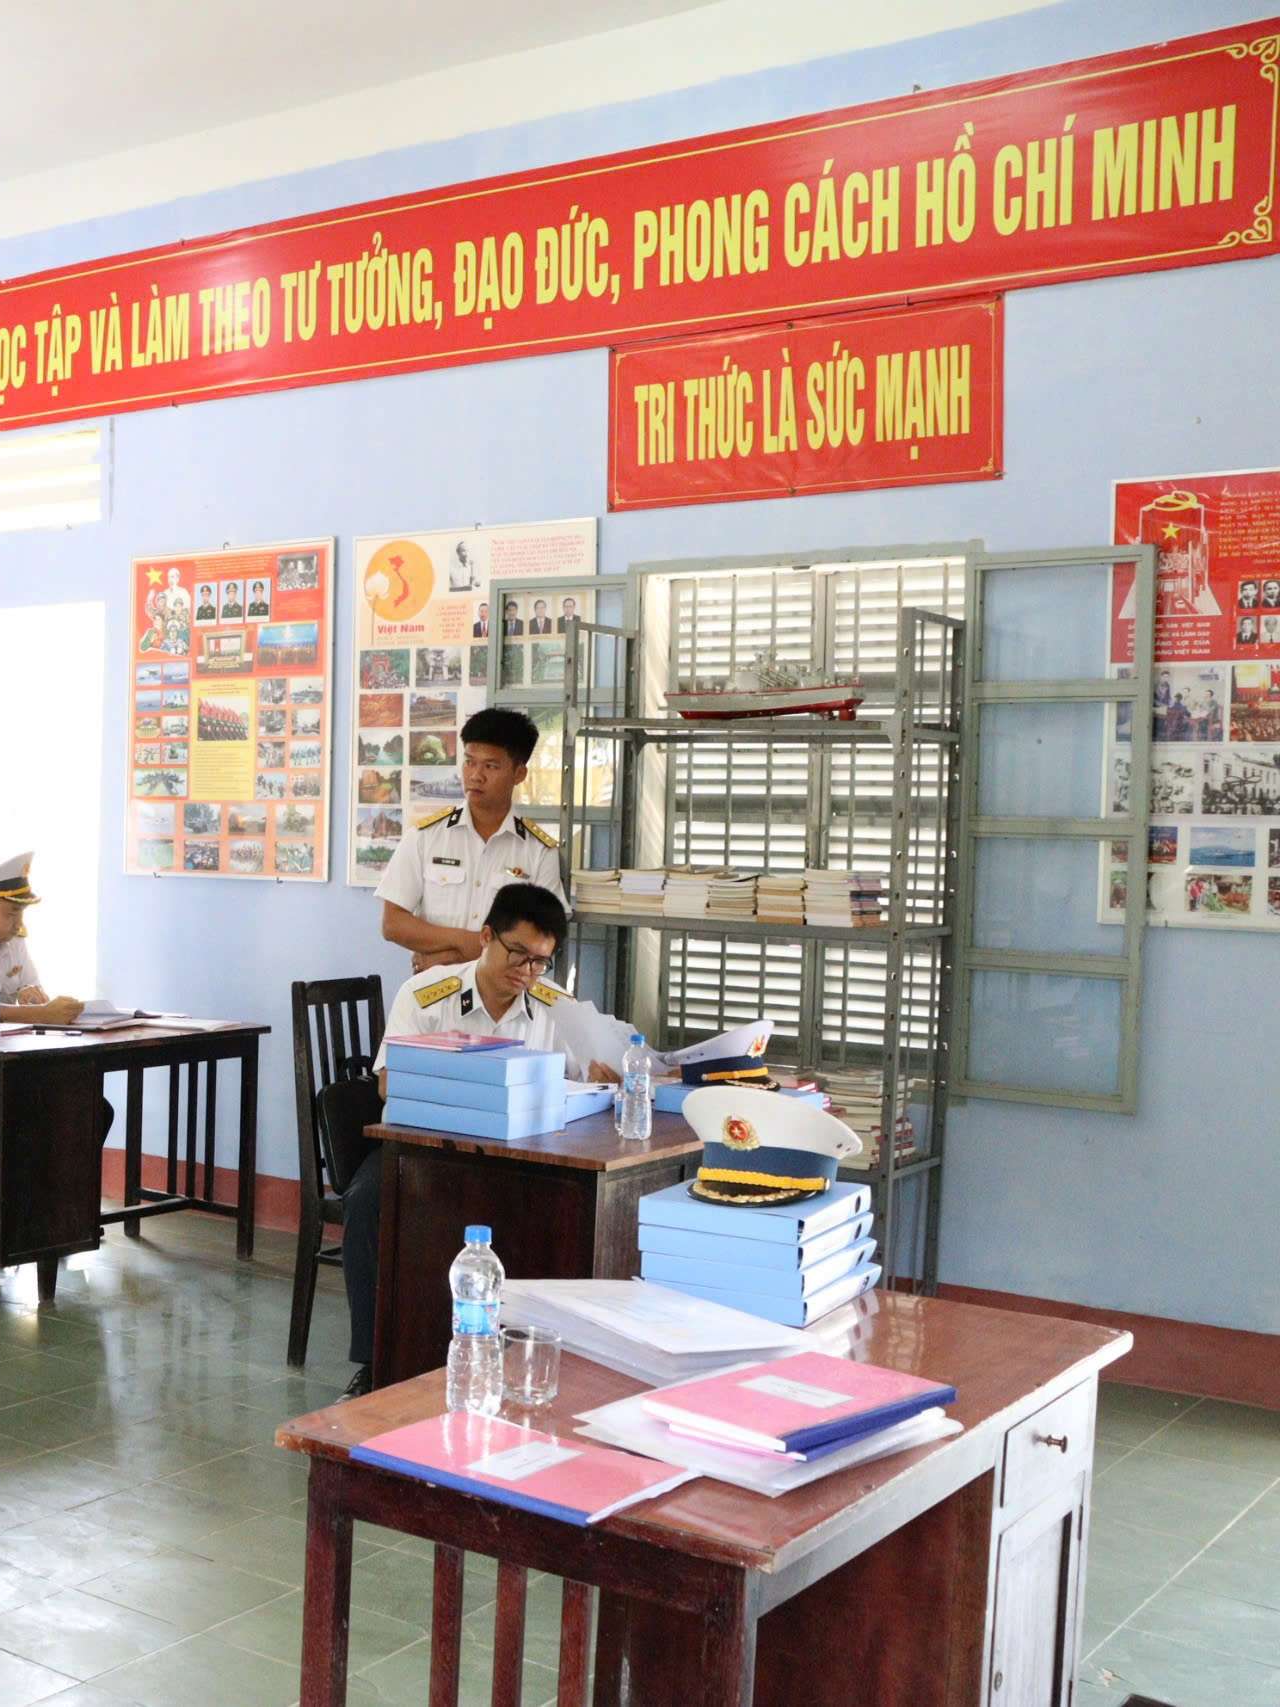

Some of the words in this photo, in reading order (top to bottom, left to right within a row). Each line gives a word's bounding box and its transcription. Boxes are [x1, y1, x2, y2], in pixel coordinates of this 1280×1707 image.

[35, 304, 81, 396] TẬP
[90, 293, 122, 374] VÀ
[132, 285, 190, 367] LÀM
[198, 276, 271, 356] THEO
[281, 261, 320, 342] TƯ
[328, 232, 442, 335] TƯỞNG,
[454, 233, 523, 329] ĐẠO
[535, 206, 619, 304] ĐỨC,
[634, 190, 768, 289] PHONG
[785, 159, 899, 267] CÁCH
[916, 122, 976, 247] HỒ
[994, 114, 1075, 235] CHÍ
[1093, 106, 1235, 220] MINH
[635, 382, 674, 465] TRI
[684, 356, 753, 460] THỨC
[763, 348, 797, 453] LÀ
[807, 342, 864, 449] SỨC
[876, 345, 969, 459] MẠNH
[377, 624, 397, 635] Việt
[400, 624, 424, 633] Nam
